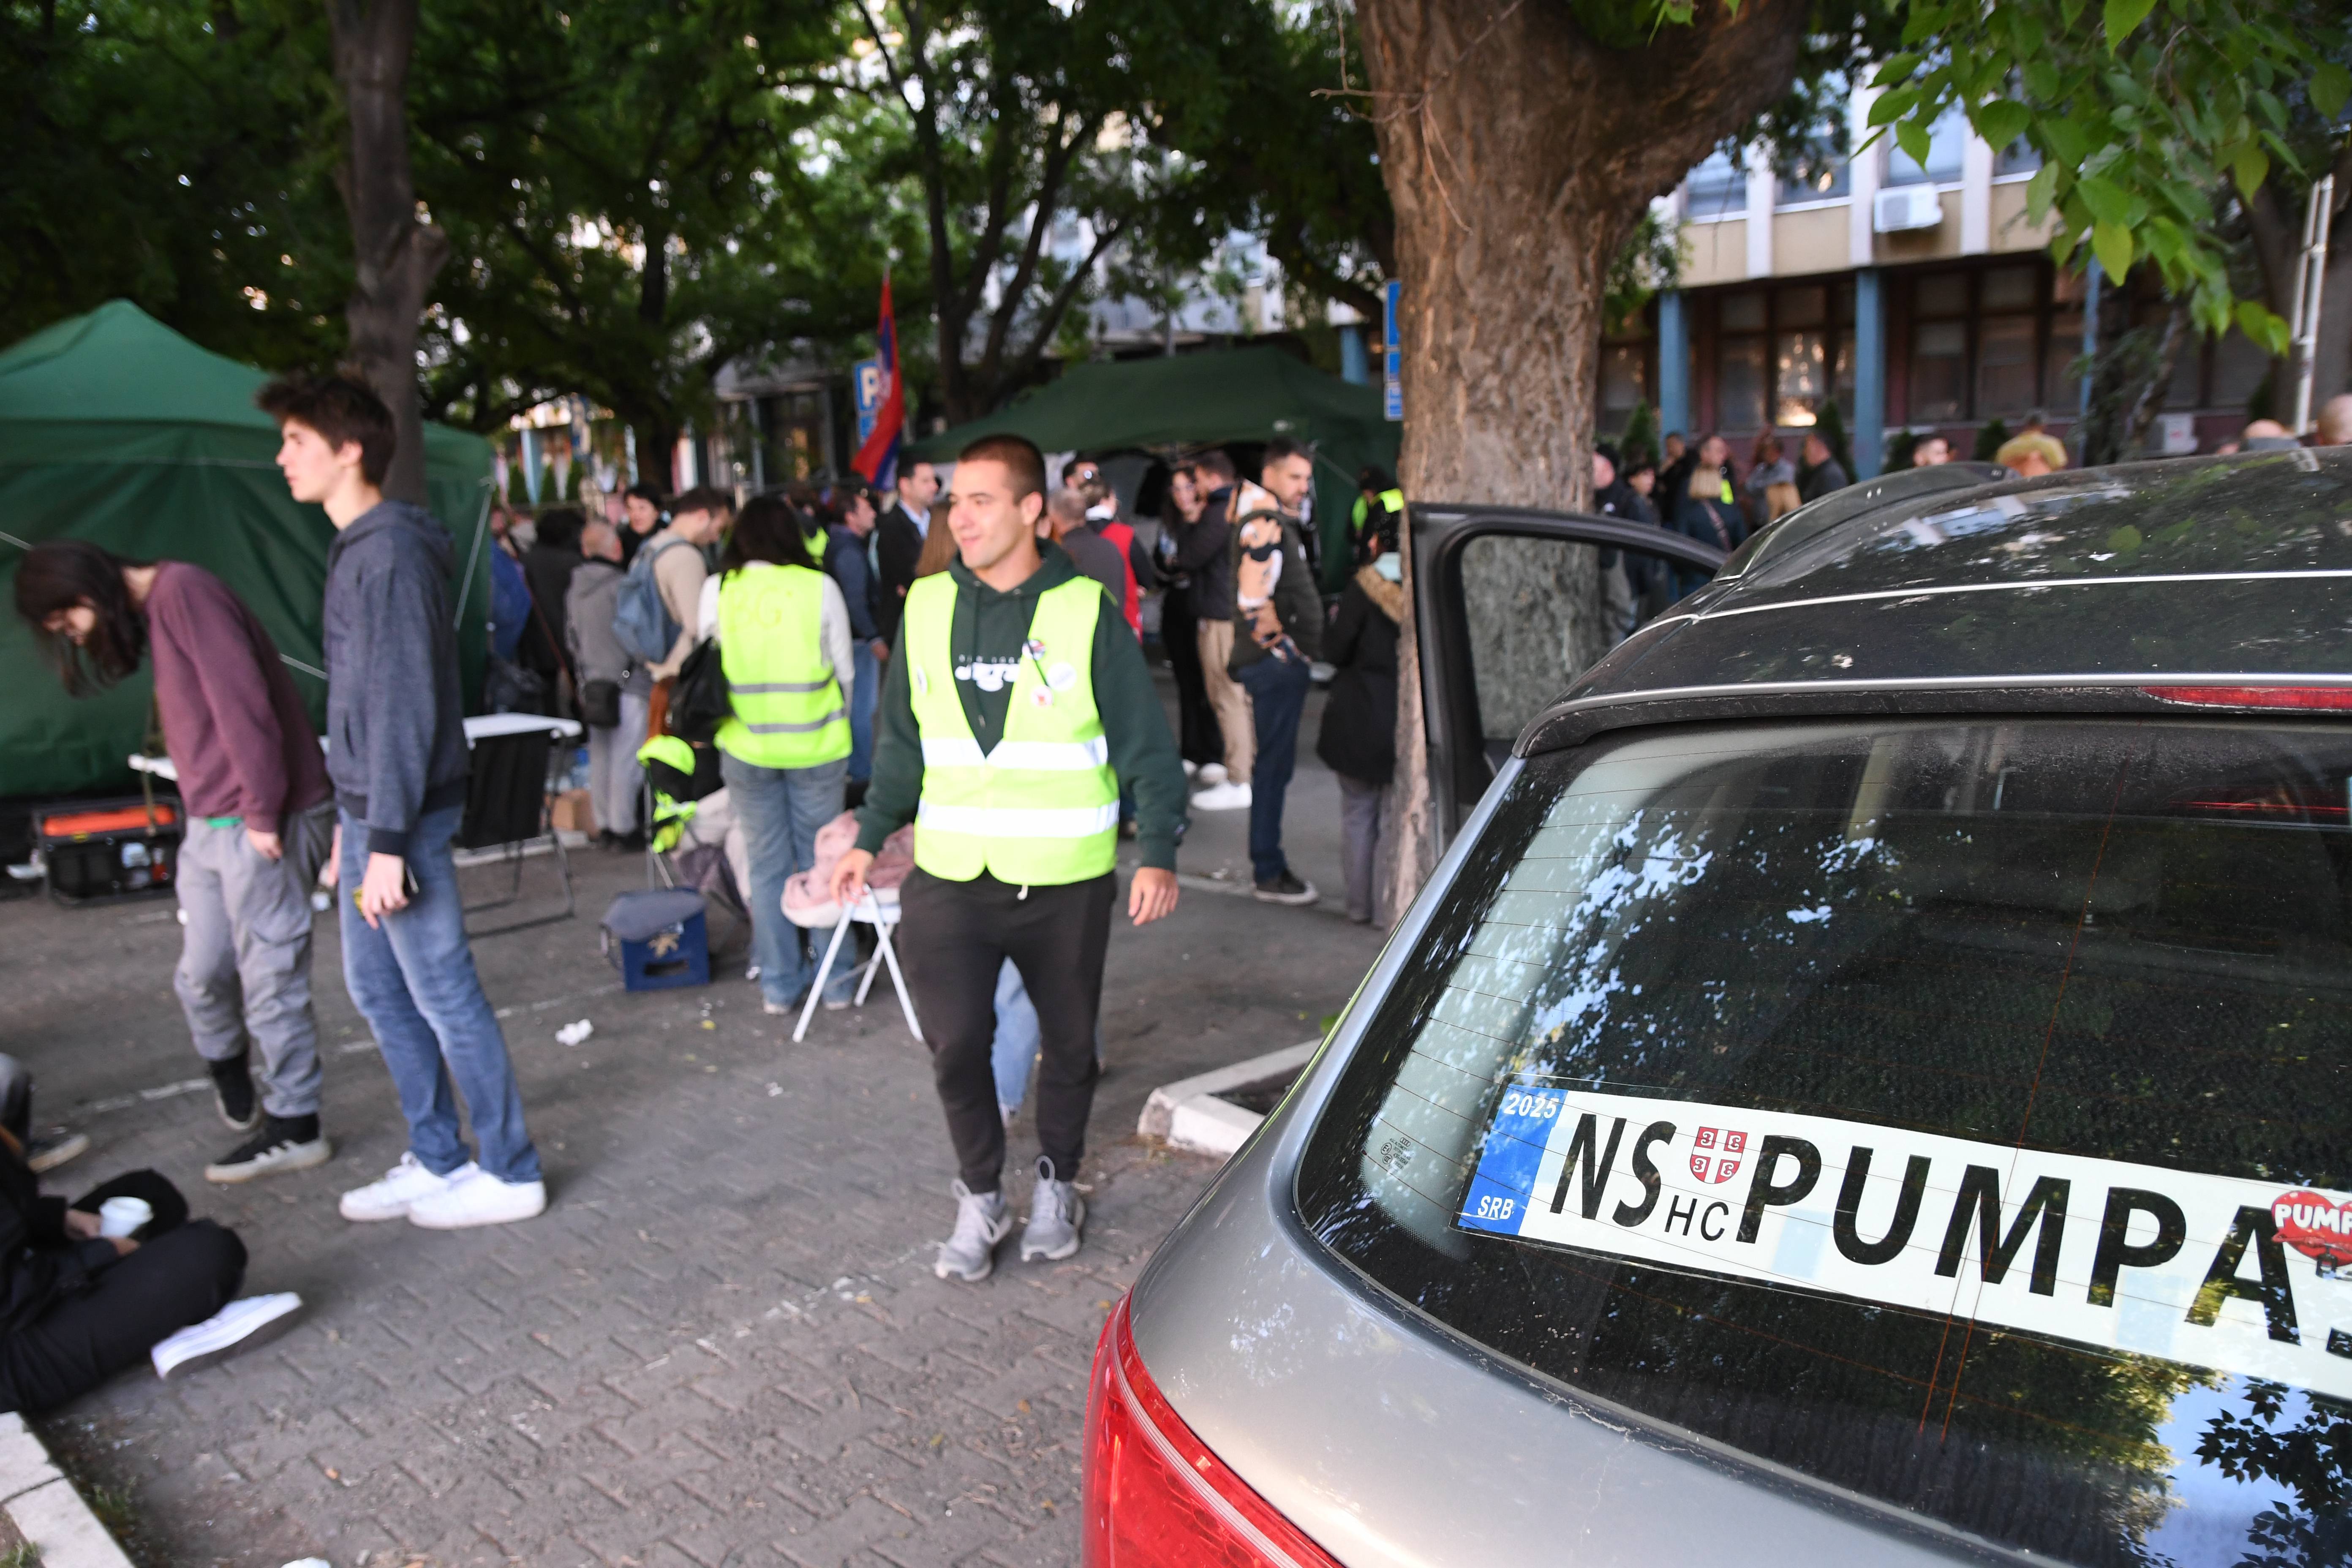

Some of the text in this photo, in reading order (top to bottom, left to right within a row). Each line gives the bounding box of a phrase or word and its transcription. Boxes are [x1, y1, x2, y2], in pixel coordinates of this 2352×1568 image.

[861, 366, 879, 408] P
[1504, 1094, 1559, 1119] 2025
[1478, 1195, 1515, 1220] SRB
[1549, 1113, 2352, 1360] NS PUMPA
